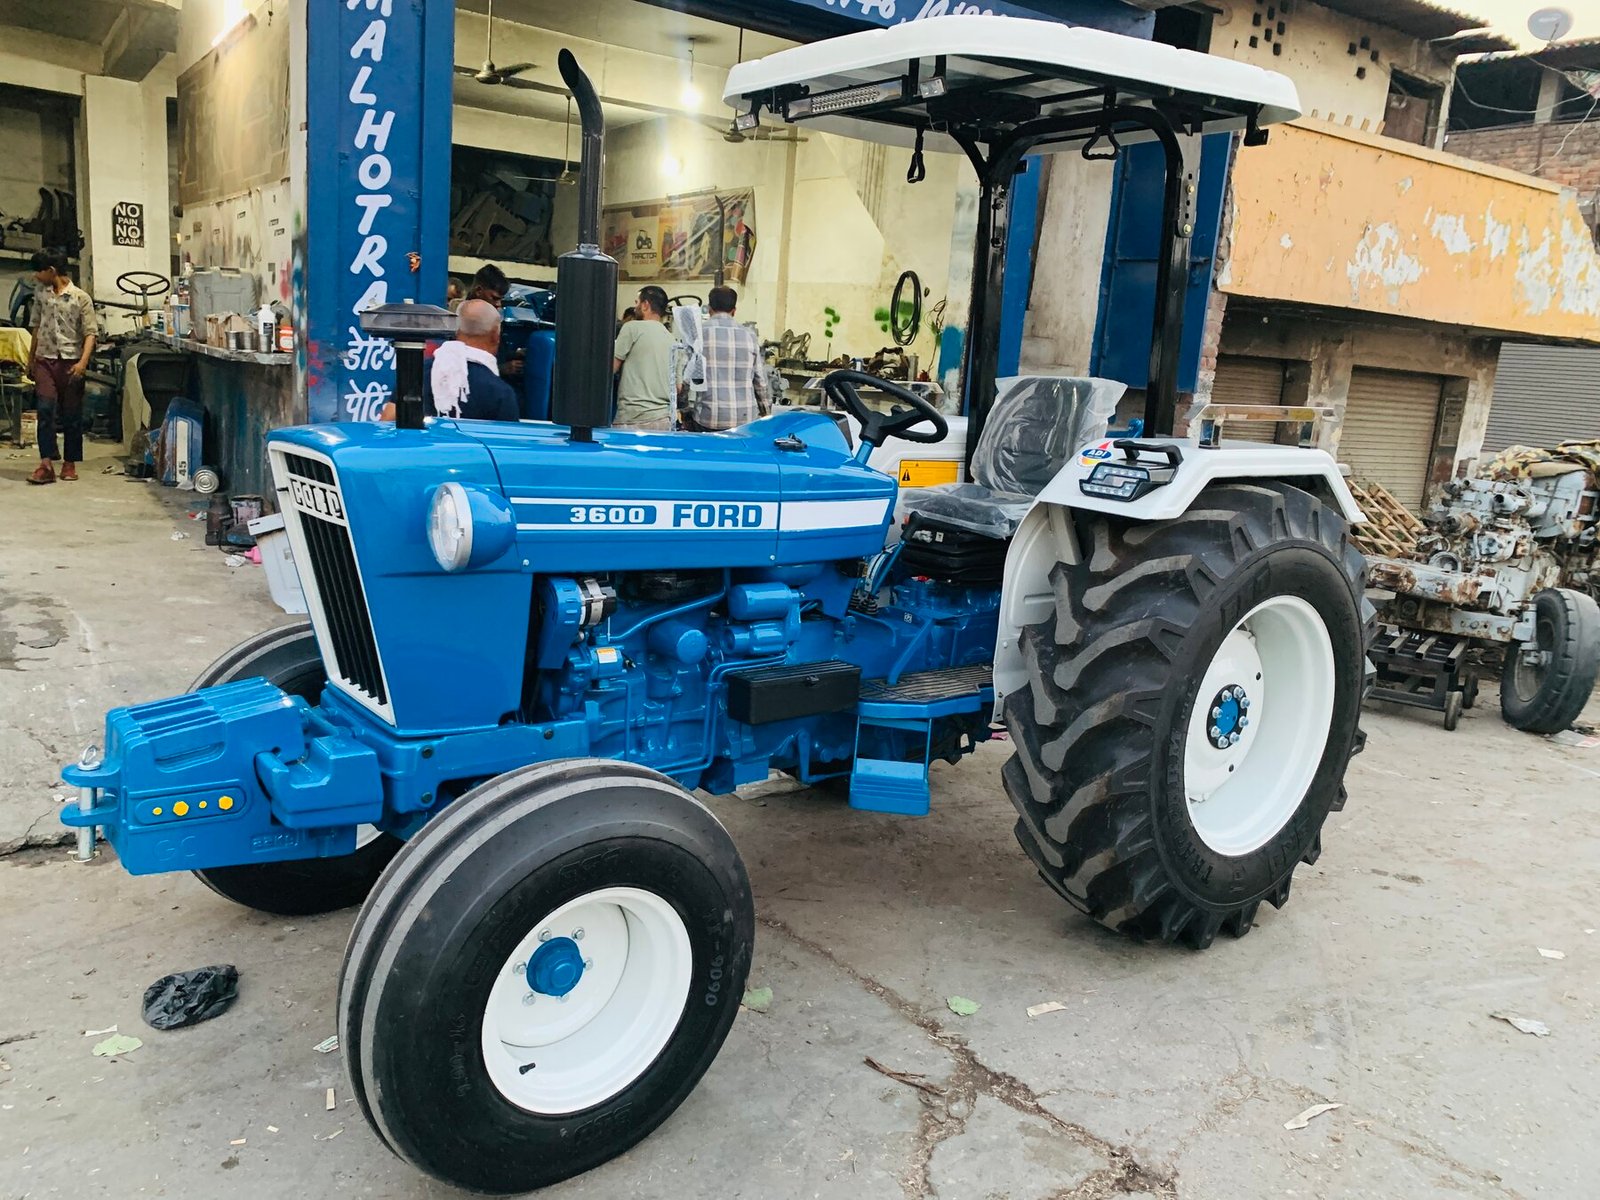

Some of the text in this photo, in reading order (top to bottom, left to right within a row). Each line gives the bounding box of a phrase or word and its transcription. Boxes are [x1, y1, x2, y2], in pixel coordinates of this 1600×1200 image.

[115, 204, 140, 218] NO
[118, 216, 138, 226] PAIN
[116, 224, 141, 239] NO
[118, 236, 140, 246] GAIN
[1087, 449, 1108, 457] ADI
[289, 479, 344, 520] FORD
[569, 504, 762, 528] 3600 FORD
